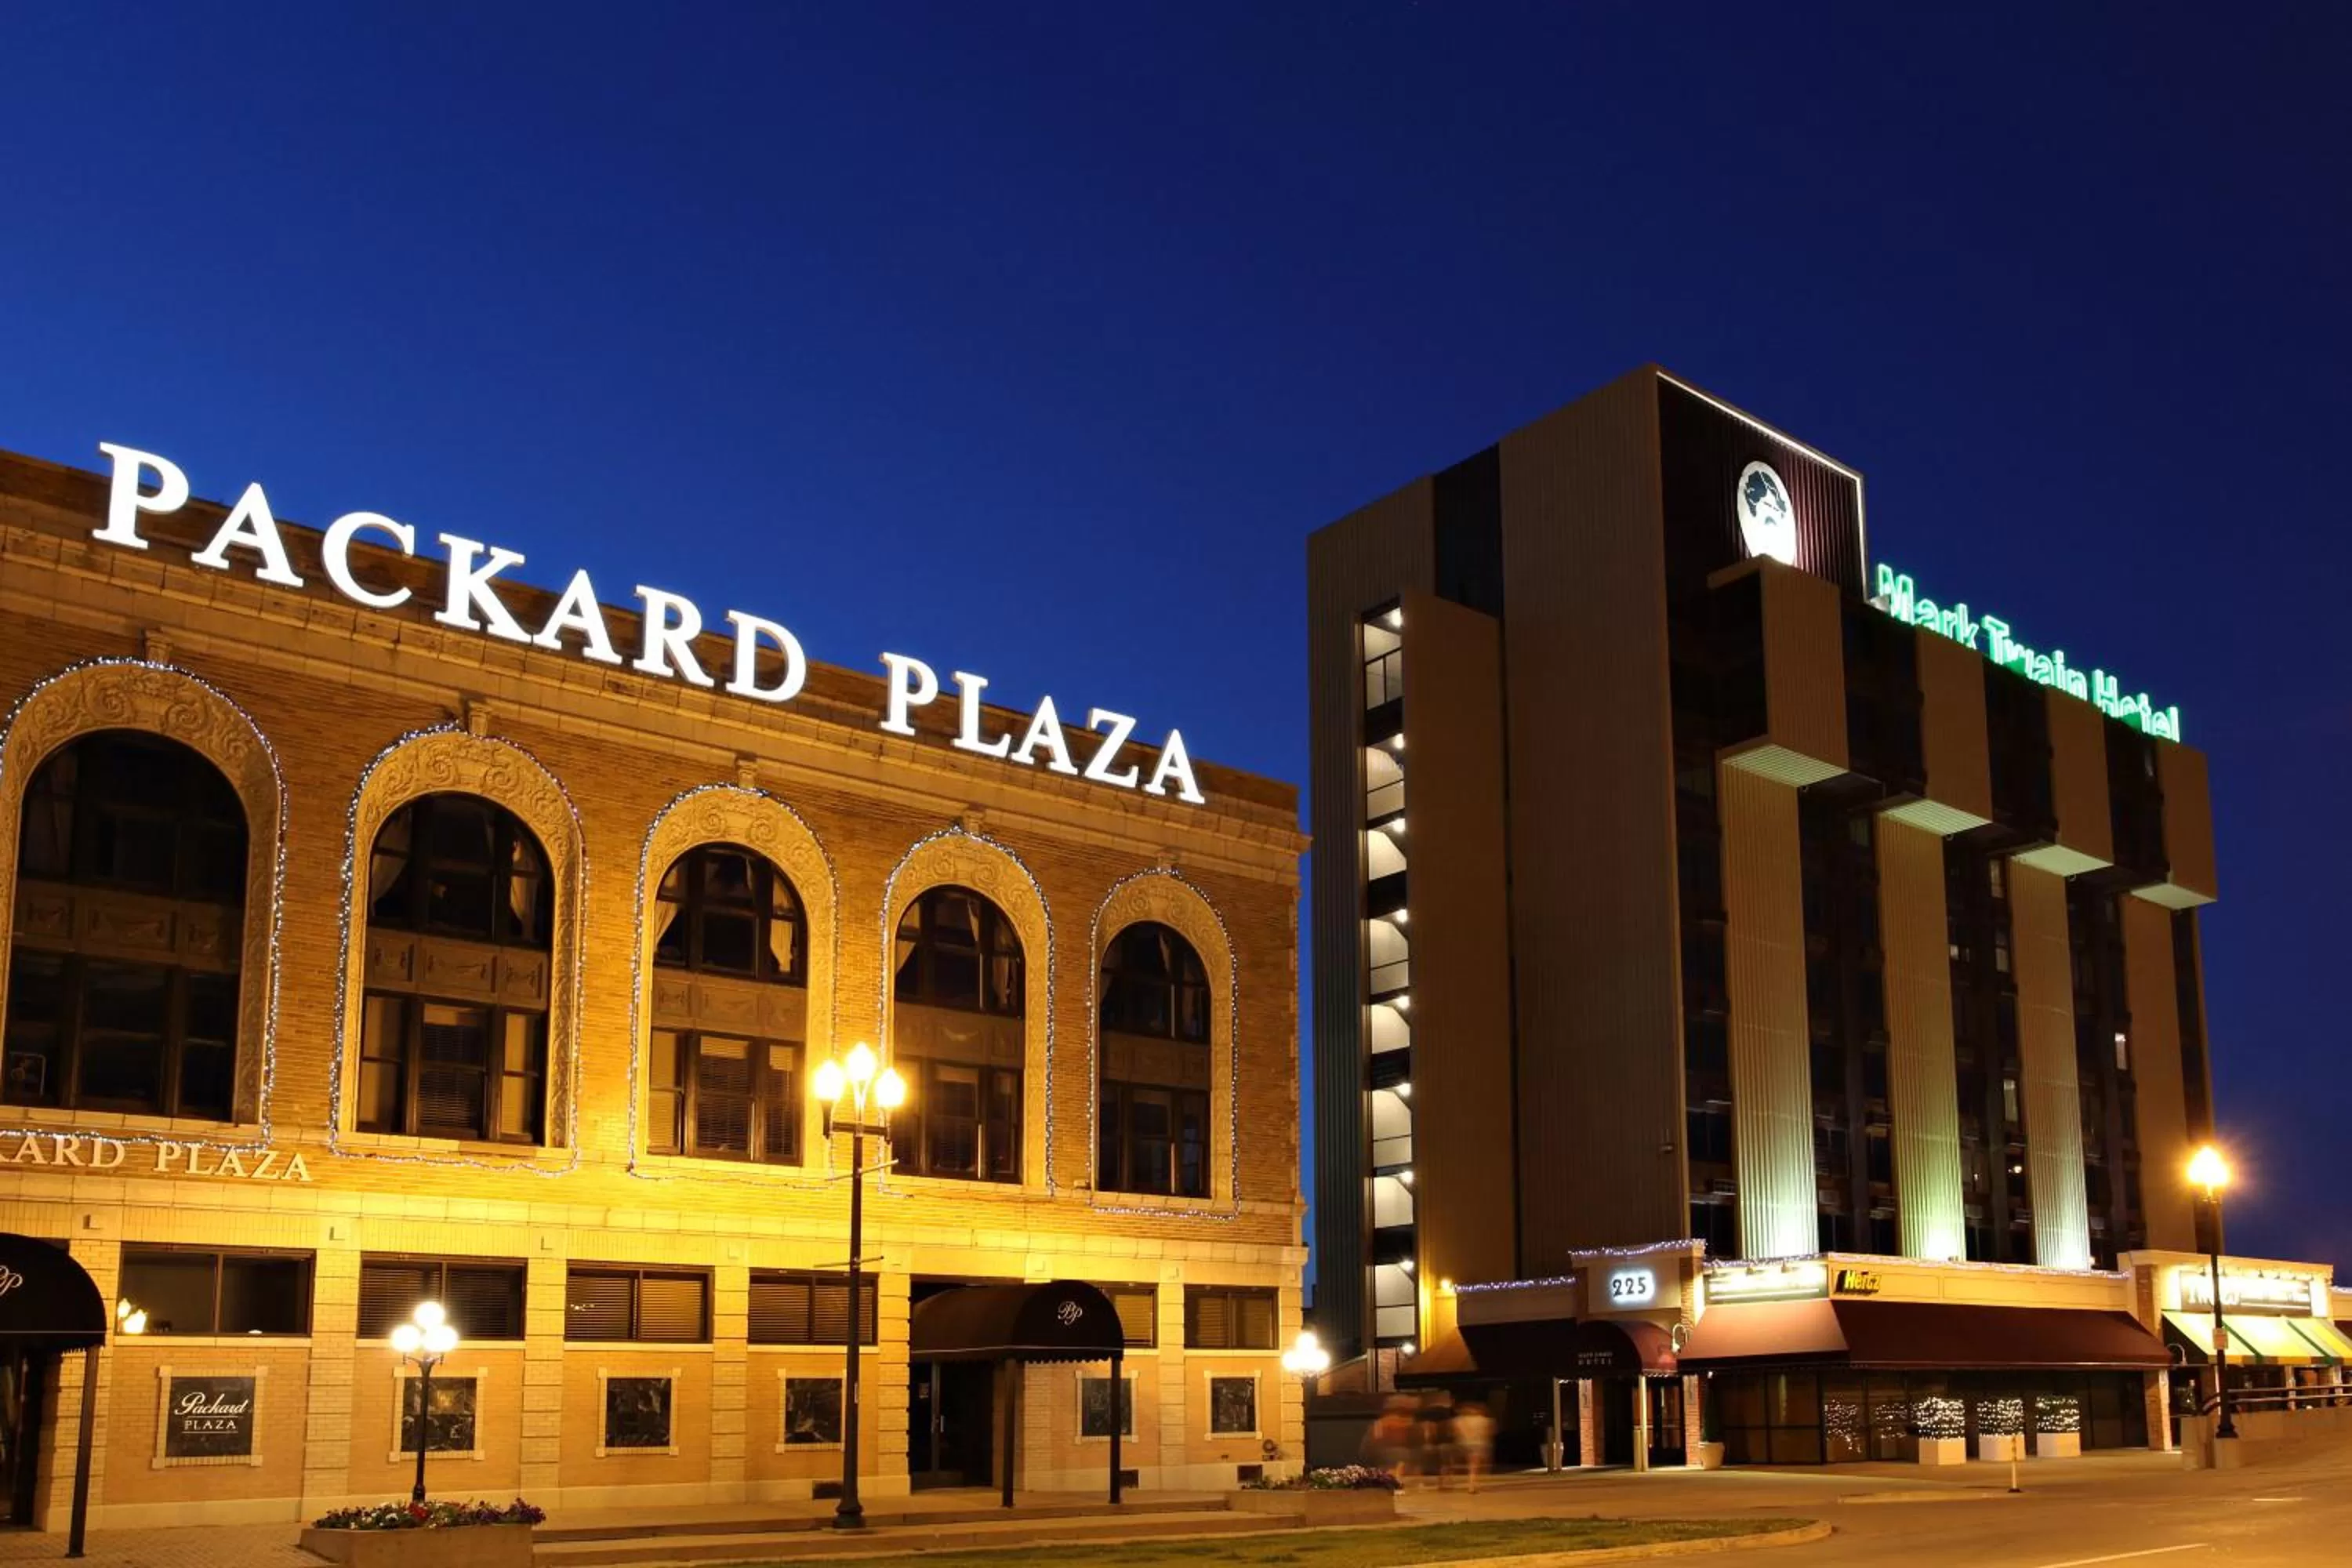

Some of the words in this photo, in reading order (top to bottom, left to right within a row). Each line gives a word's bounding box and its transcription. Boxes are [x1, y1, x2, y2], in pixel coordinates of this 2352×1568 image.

[92, 441, 808, 703] PACKARD
[879, 651, 1207, 805] PLAZA
[1877, 563, 1980, 651] Mark
[1980, 614, 2089, 702] Twain
[2092, 669, 2181, 744] Hotel
[0, 1134, 126, 1168] ARD
[153, 1140, 314, 1182] PLAZA
[1613, 1276, 1646, 1298] 225
[1842, 1269, 1882, 1291] Hertz
[173, 1392, 249, 1415] Packard
[183, 1420, 237, 1431] PLAZA
